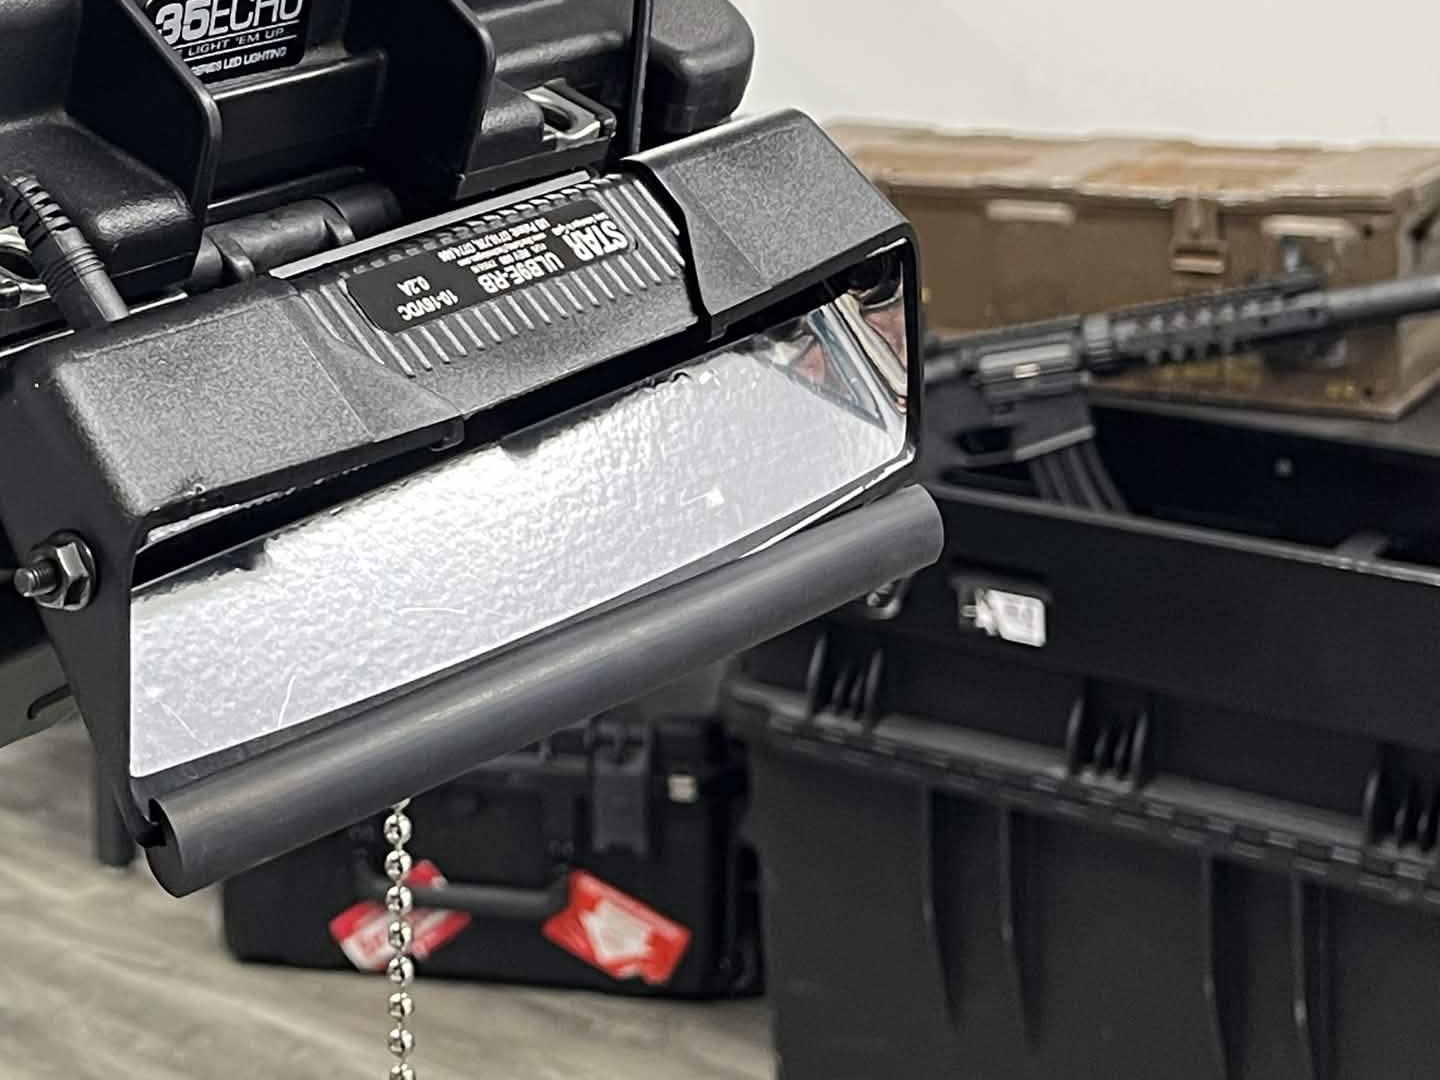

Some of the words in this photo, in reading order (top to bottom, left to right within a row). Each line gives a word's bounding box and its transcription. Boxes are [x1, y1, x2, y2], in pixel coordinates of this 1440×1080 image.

[187, 38, 231, 56] LIGHT
[235, 31, 260, 46] 'EM
[264, 26, 285, 39] UP
[223, 56, 243, 70] LED
[243, 46, 288, 66] LIGHTING
[561, 219, 628, 262] STAR
[396, 275, 431, 297] 0.2A
[477, 251, 565, 294] ULB9E-RB
